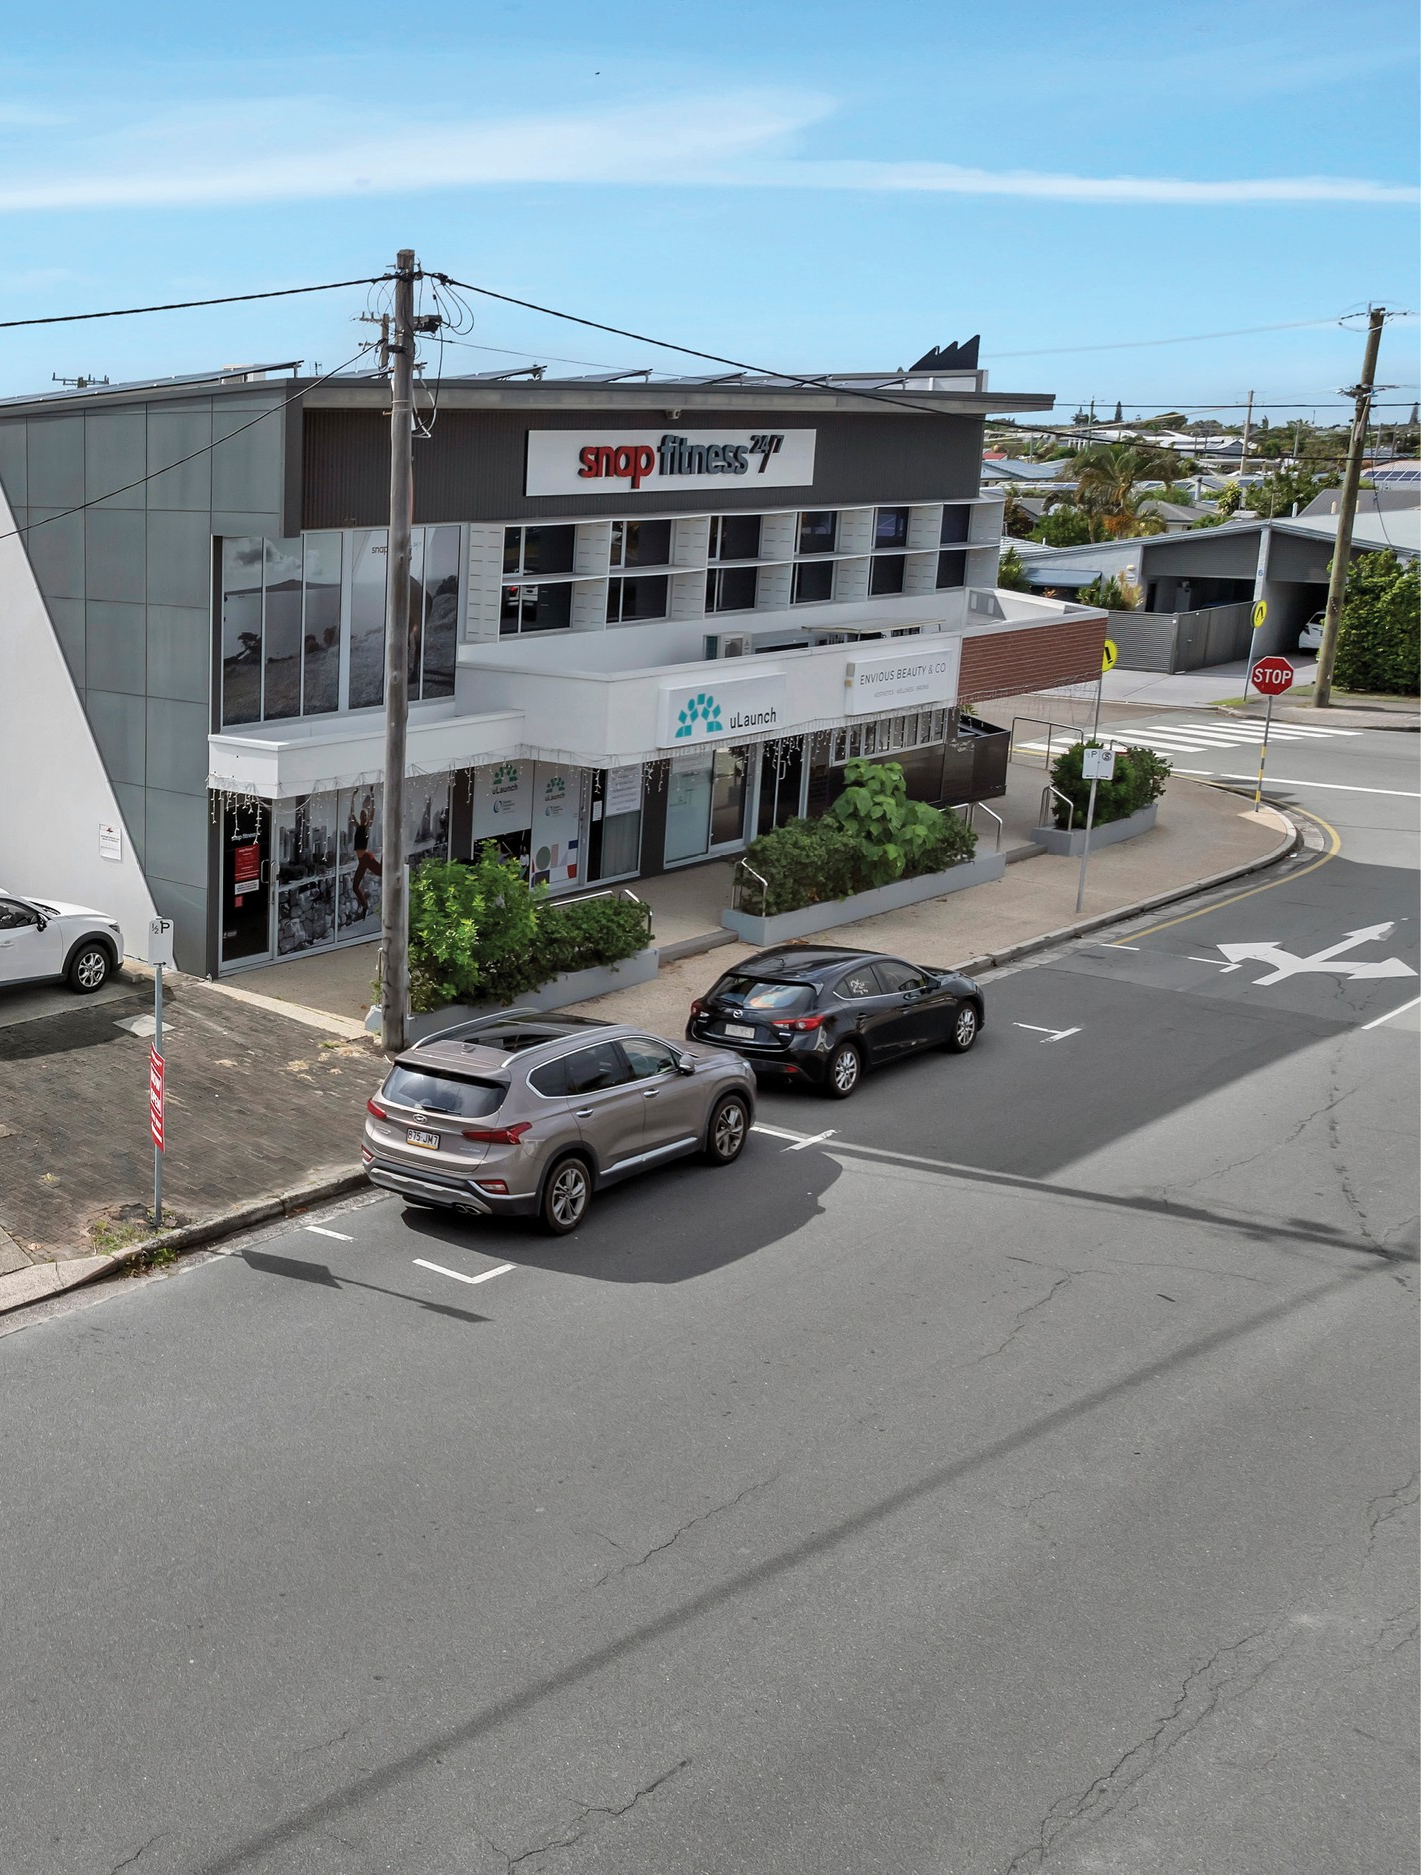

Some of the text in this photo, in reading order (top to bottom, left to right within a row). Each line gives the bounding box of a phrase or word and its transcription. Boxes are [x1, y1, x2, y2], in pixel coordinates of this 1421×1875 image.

[578, 434, 786, 489] snap fitness 24/7
[859, 670, 895, 686] ENVIOUS
[896, 665, 927, 680] BEAUTY
[934, 662, 947, 674] CO
[1253, 668, 1292, 685] STOP
[730, 706, 777, 729] uLaunch
[491, 783, 519, 796] uLaunch
